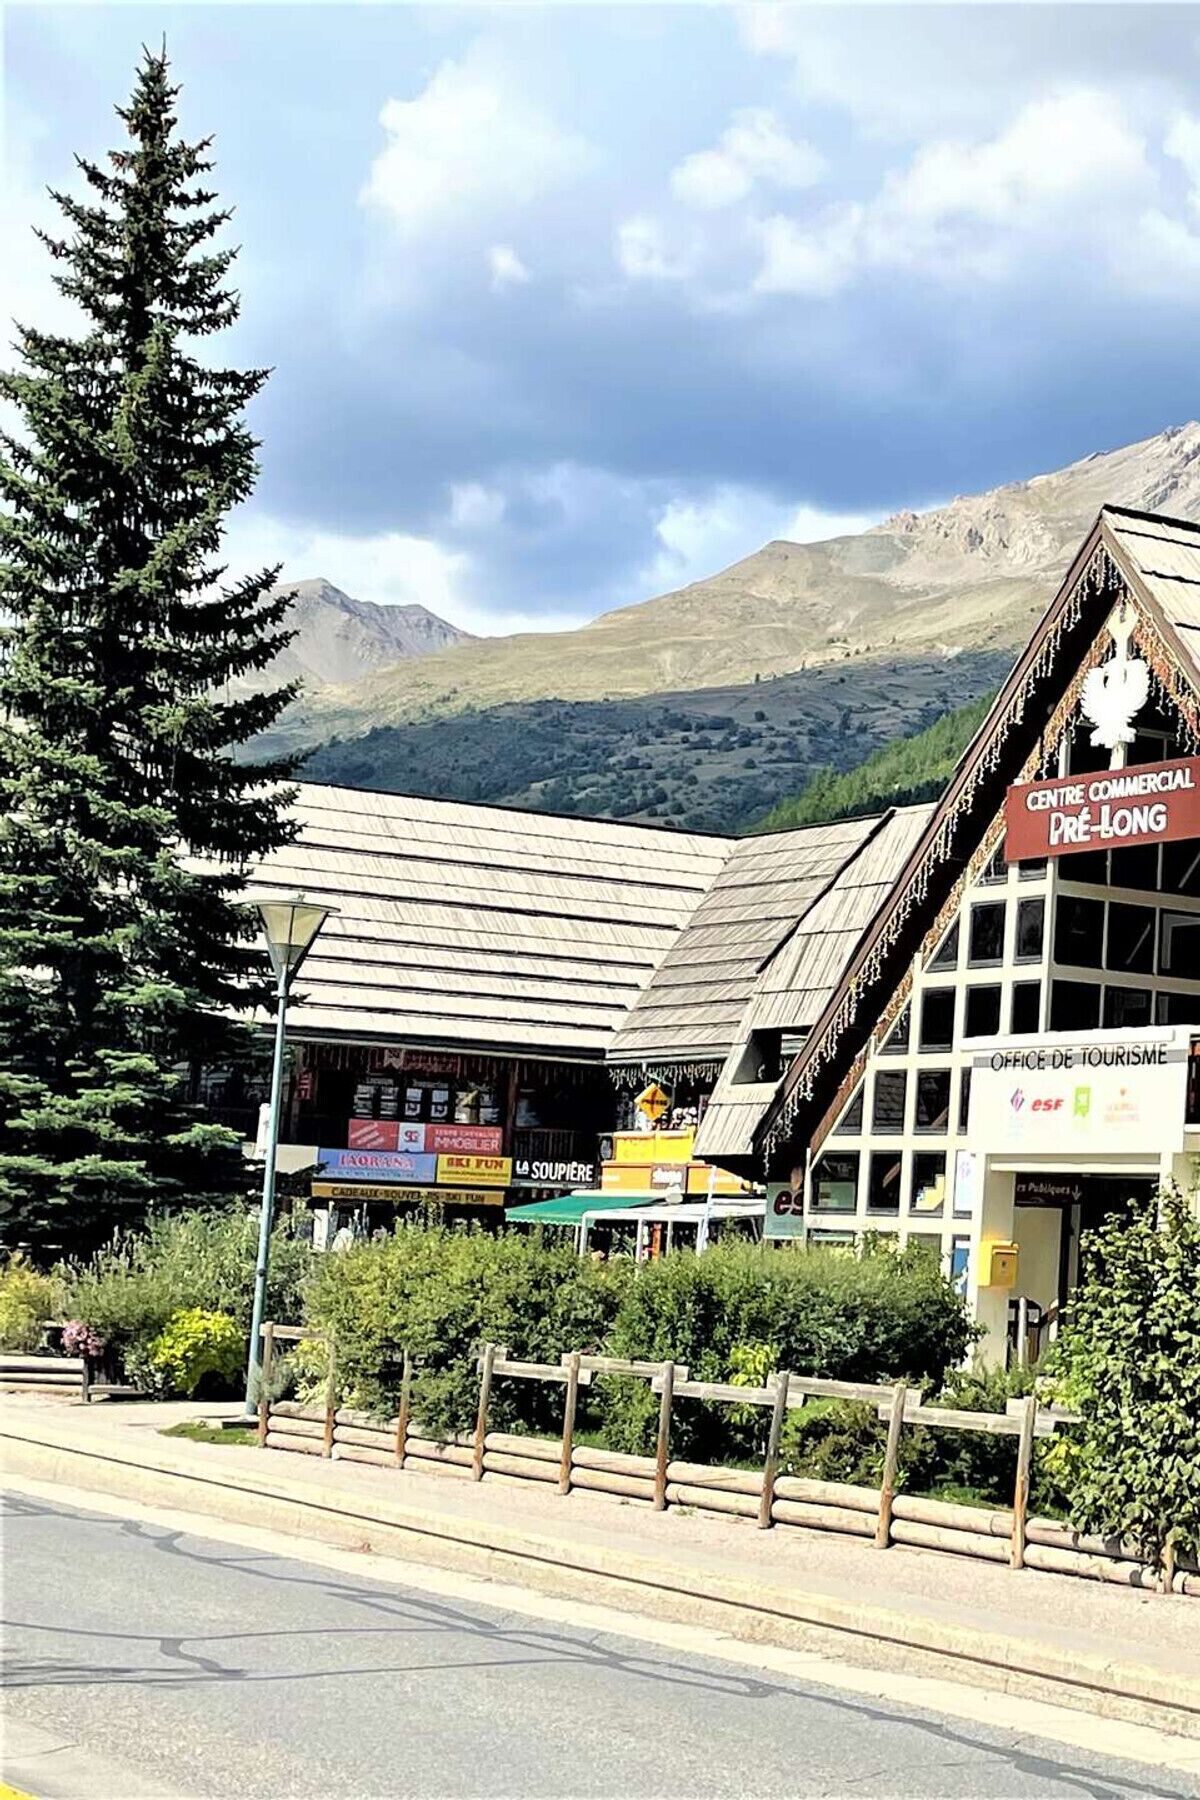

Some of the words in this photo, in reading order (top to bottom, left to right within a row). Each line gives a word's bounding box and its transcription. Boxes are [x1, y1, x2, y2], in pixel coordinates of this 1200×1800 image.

[1026, 783, 1085, 812] CENTRE
[1088, 768, 1196, 803] COMMERCIAL
[1049, 804, 1168, 846] PRÉ-LONG
[991, 1051, 1046, 1071] OFFICE
[1052, 1051, 1074, 1070] DE
[1081, 1043, 1168, 1067] TOURISME
[434, 1136, 500, 1150] IMMOBILIER
[447, 1157, 470, 1168] SKI
[476, 1158, 504, 1170] FUN
[515, 1160, 530, 1174] LA
[532, 1161, 594, 1182] SOUPIÈRE
